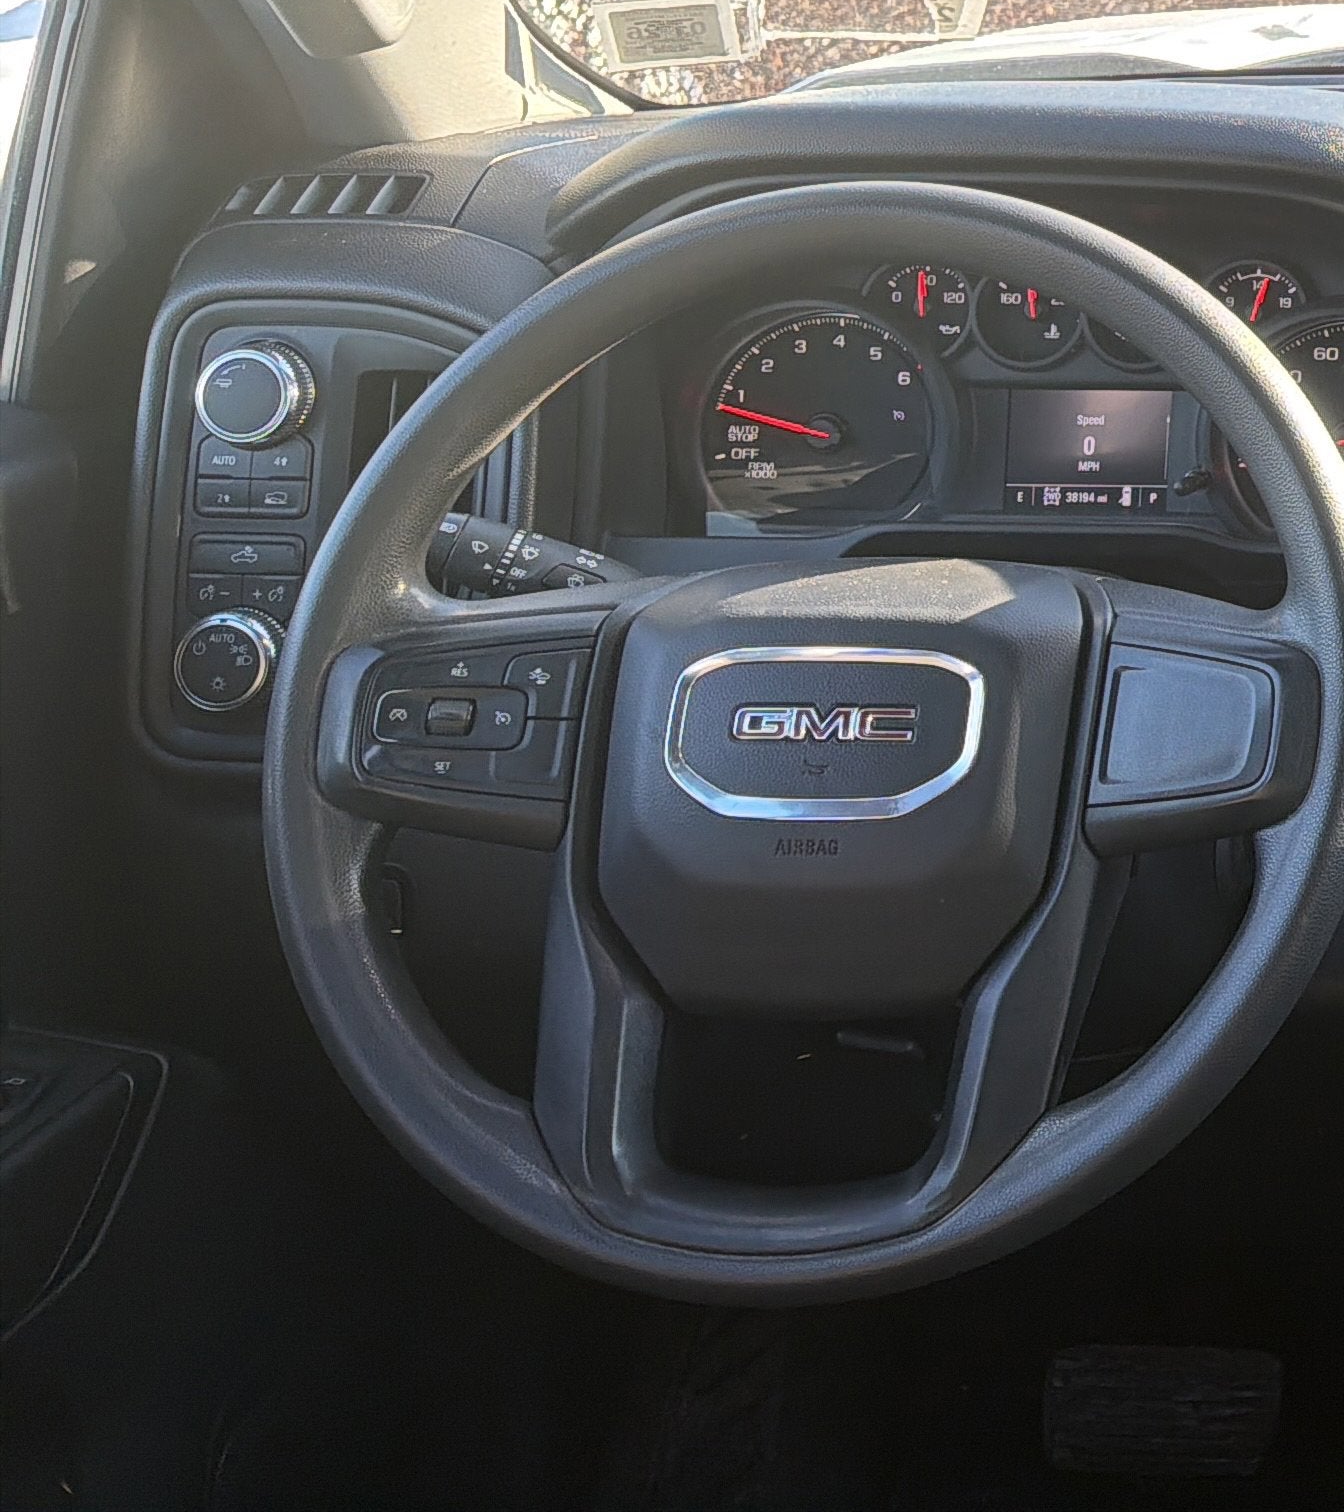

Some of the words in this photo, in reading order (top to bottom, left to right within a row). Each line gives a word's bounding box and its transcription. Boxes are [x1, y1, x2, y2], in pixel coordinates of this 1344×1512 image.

[892, 292, 901, 303] 0
[943, 292, 964, 304] 120
[1000, 293, 1021, 305] 160
[1226, 296, 1235, 307] 9
[1279, 297, 1292, 309] 19
[794, 340, 807, 354] 3
[832, 335, 846, 349] 4
[869, 347, 882, 361] 5
[1313, 348, 1339, 361] 60
[761, 359, 774, 373] 2
[897, 371, 911, 385] 6
[738, 389, 745, 402] 1
[1077, 415, 1105, 427] Speed
[727, 425, 759, 434] AUTO
[727, 433, 758, 442] STOP
[1083, 435, 1096, 456] 0
[730, 448, 760, 460] OFF
[211, 455, 236, 466] AUTO
[748, 461, 775, 471] RPM
[1078, 460, 1100, 472] MPH
[1017, 491, 1024, 502] E
[1065, 492, 1095, 503] 38194
[1097, 494, 1108, 503] mi
[1149, 493, 1158, 503] P
[509, 566, 528, 579] OFF
[208, 633, 235, 644] AUTO
[450, 667, 468, 677] RES
[731, 704, 919, 743] GMC
[433, 761, 452, 770] SET
[774, 838, 839, 856] AIRBAG
